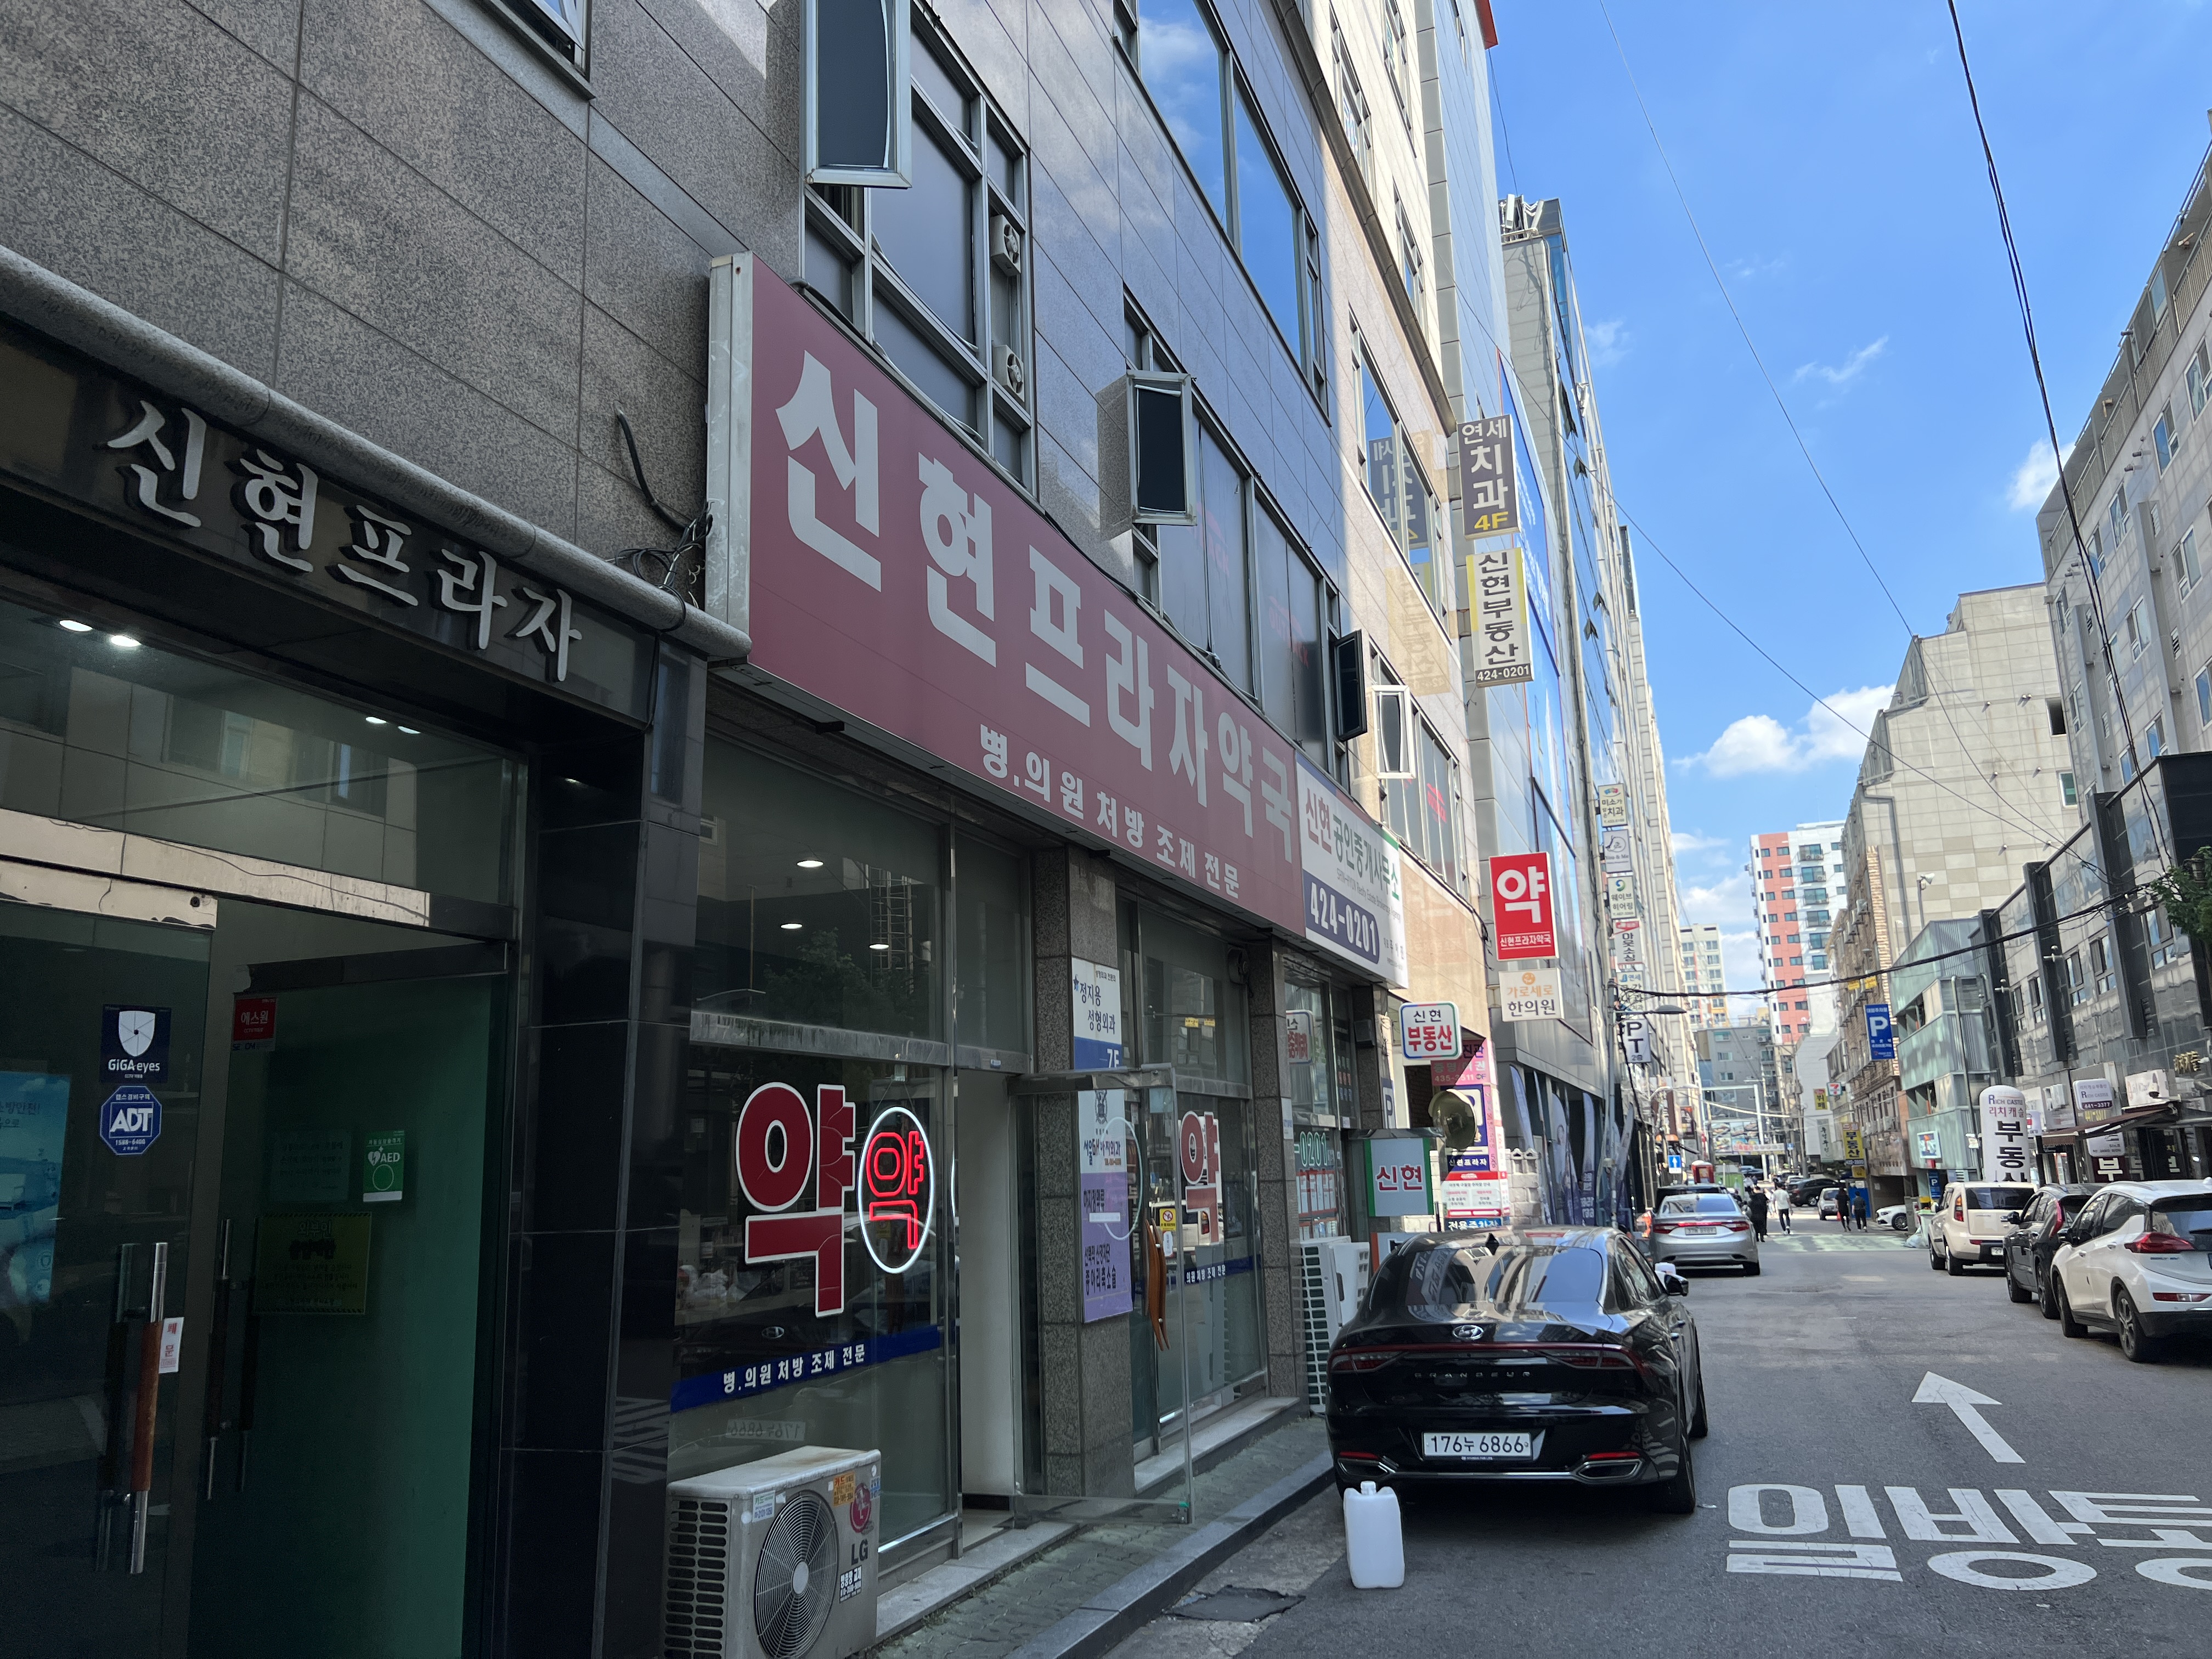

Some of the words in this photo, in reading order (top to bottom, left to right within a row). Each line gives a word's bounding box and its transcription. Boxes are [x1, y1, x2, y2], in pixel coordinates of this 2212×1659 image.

[1462, 418, 1507, 445] 연세
[1470, 444, 1508, 510] 치과
[1474, 511, 1508, 531] 4F
[107, 400, 582, 682] 신현프라자
[775, 350, 1293, 865] 신현프라자약국
[1479, 552, 1519, 665] 신현부동산
[1477, 665, 1530, 681] 424-0201
[980, 723, 1085, 821] 병.의원
[1096, 790, 1146, 849] 처방
[1156, 823, 1197, 868] 조제
[1204, 849, 1242, 899] 전문
[1607, 806, 1624, 816] 치과
[1306, 788, 1332, 854] 신현
[1333, 812, 1400, 901] 공인중개사무소
[1496, 866, 1545, 924] 약
[1310, 882, 1376, 956] 424-0201
[1500, 934, 1551, 947] 신현프라자약국
[1622, 933, 1635, 962] 아웃소싱
[1080, 983, 1101, 1007] 정지용
[1506, 985, 1554, 997] 가로세로
[240, 1010, 268, 1025] 에스원
[1413, 1009, 1442, 1023] 신현
[1507, 999, 1555, 1017] 한의원
[1088, 1009, 1115, 1035] 성형외과
[1869, 1016, 1888, 1037] P
[1407, 1025, 1452, 1052] 부동산
[1107, 1048, 1120, 1068] 7F
[1385, 1094, 1392, 1128] P
[1988, 1094, 2005, 1104] RICH
[110, 1107, 154, 1132] ADT
[1989, 1107, 2024, 1118] 리치캐슬
[380, 1152, 400, 1163] AED
[1846, 1132, 1860, 1158] 부동산
[1449, 1158, 1487, 1167] 신현프라자
[1179, 1110, 1223, 1244] 약
[1376, 1164, 1423, 1191] 신현
[736, 1082, 856, 1318] 약
[866, 1131, 925, 1250] 약
[297, 1220, 332, 1238] 외부인
[1086, 1265, 1116, 1296] 종아리축소술
[1197, 1269, 1205, 1281] 처방
[1207, 1266, 1216, 1279] 조제
[1217, 1264, 1226, 1276] 전문
[723, 1363, 772, 1393] 병.의원
[778, 1358, 804, 1380] 처방
[811, 1350, 835, 1374] 조제
[842, 1344, 866, 1364] 전문
[1431, 1436, 1475, 1453] 176누
[1479, 1436, 1525, 1453] 6866
[851, 1538, 868, 1566] LG
